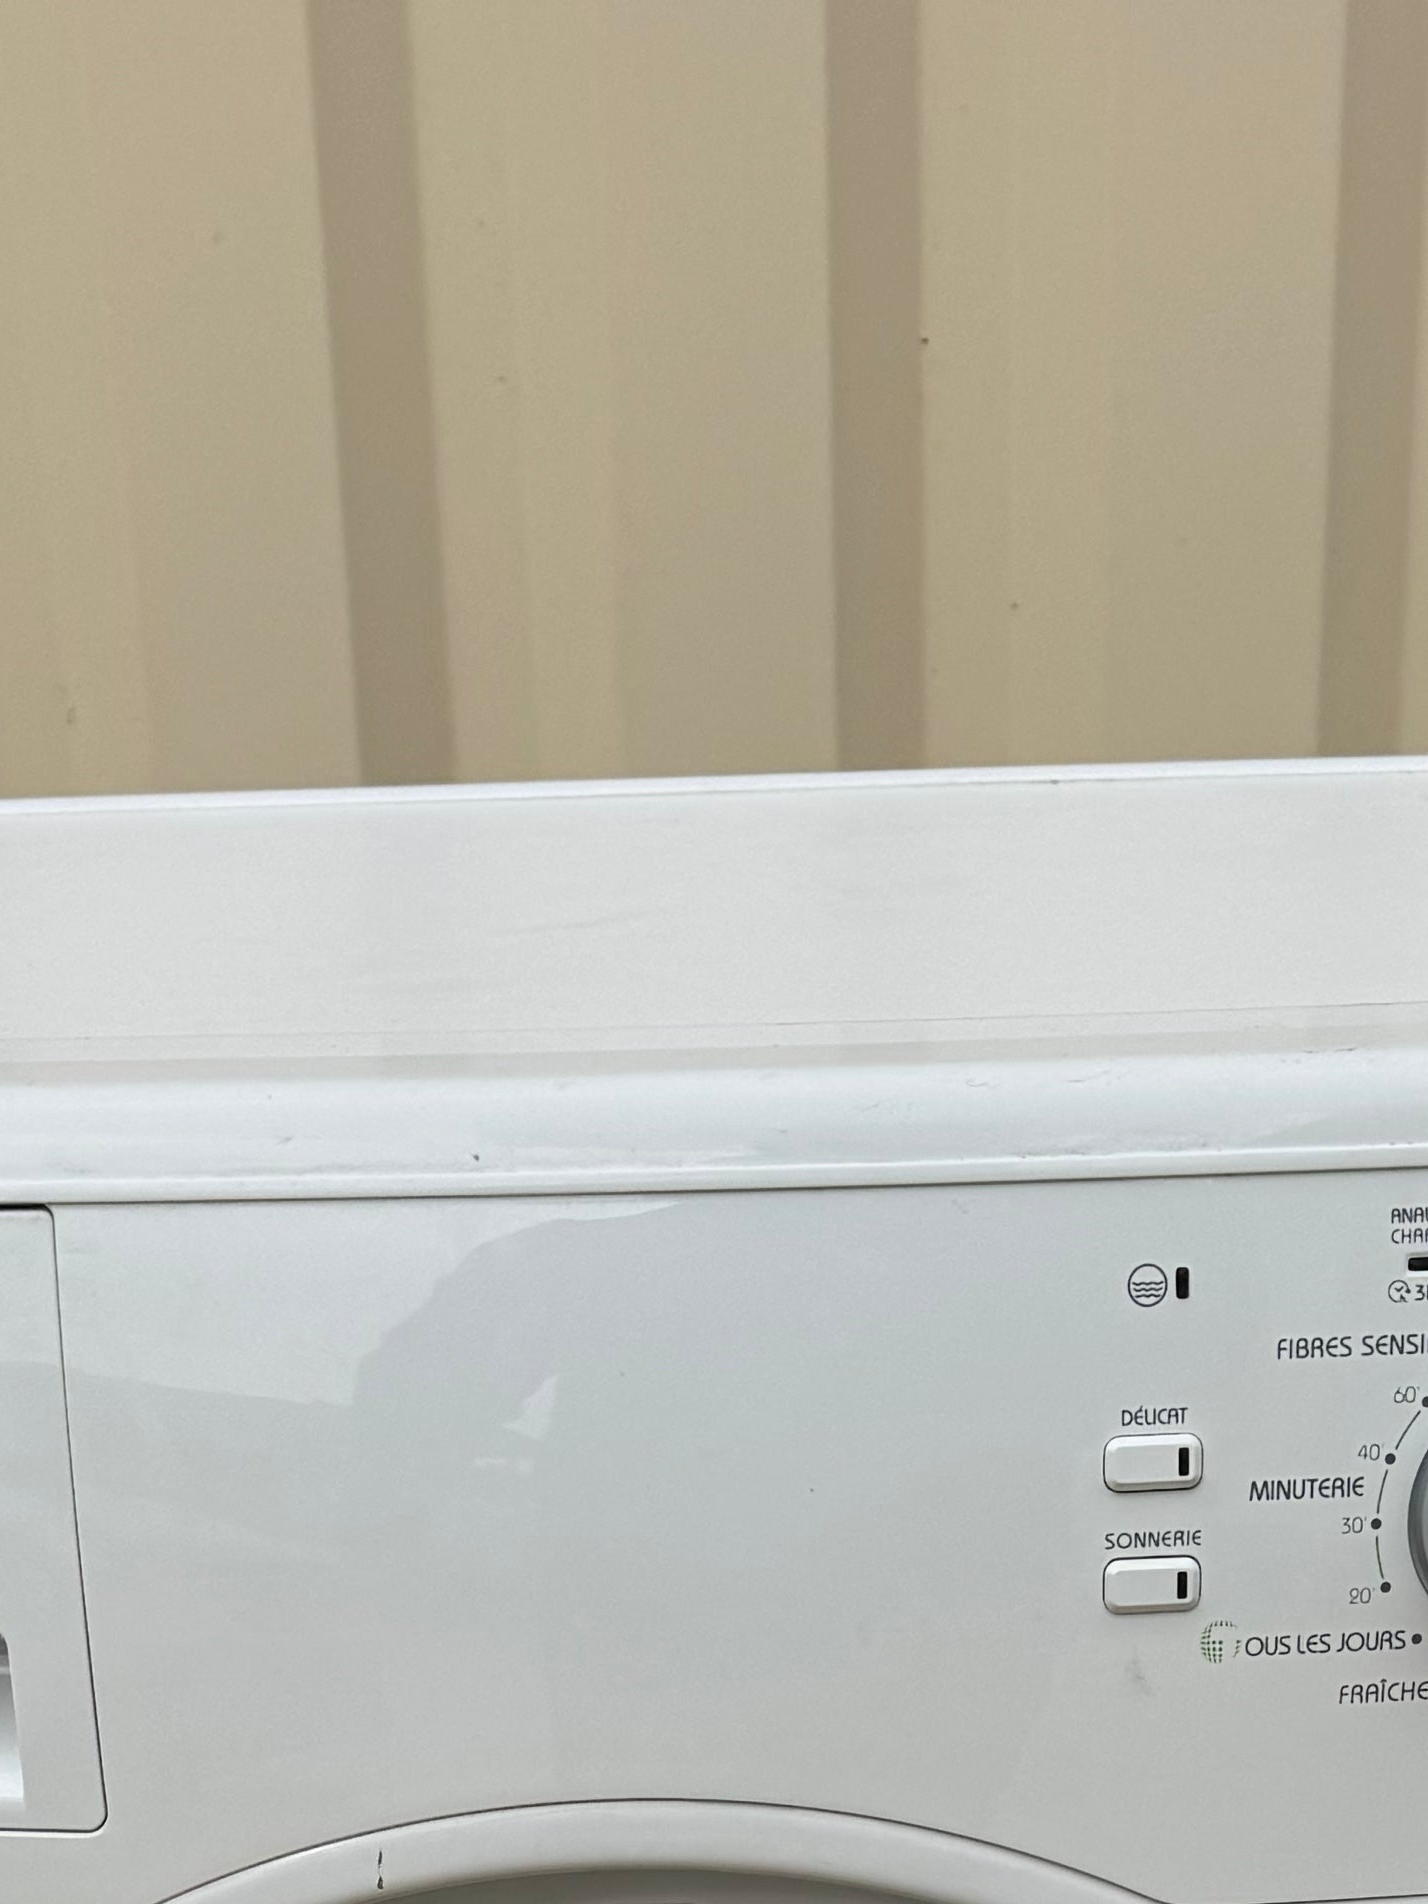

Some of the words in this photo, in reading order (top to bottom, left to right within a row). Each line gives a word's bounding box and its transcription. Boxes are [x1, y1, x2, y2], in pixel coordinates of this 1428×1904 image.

[1277, 1335, 1352, 1360] FIBRES
[1121, 1405, 1189, 1427] DÉLICAT
[1249, 1476, 1365, 1502] MINUTERIE
[1104, 1529, 1203, 1550] SONNERIE
[1297, 1633, 1332, 1653] LES
[1336, 1630, 1408, 1654] JOURS
